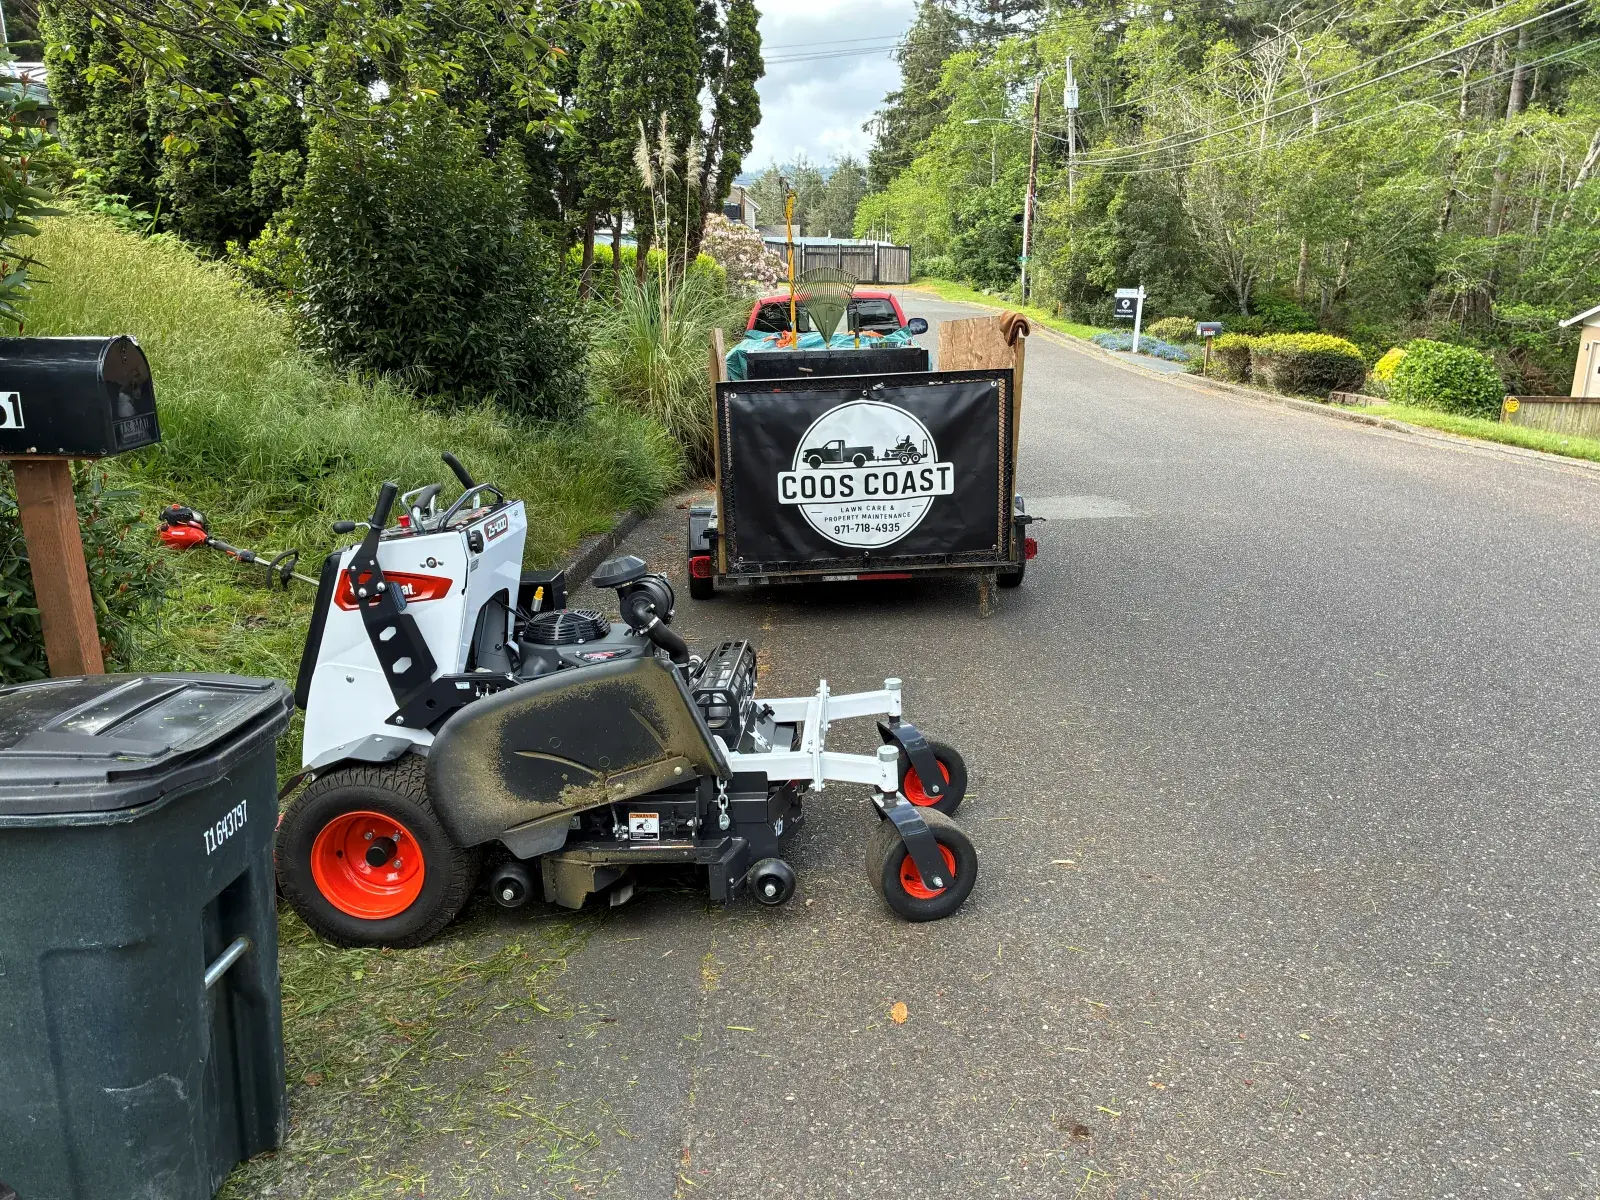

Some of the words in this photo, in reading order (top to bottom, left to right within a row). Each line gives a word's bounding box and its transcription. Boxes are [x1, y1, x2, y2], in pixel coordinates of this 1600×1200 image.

[782, 474, 854, 499] COOS
[864, 466, 951, 495] COAST
[840, 505, 862, 513] LAWN
[824, 514, 859, 522] PROPERTY
[861, 511, 911, 520] MAINTENANCE
[834, 522, 900, 535] 971-718-4935
